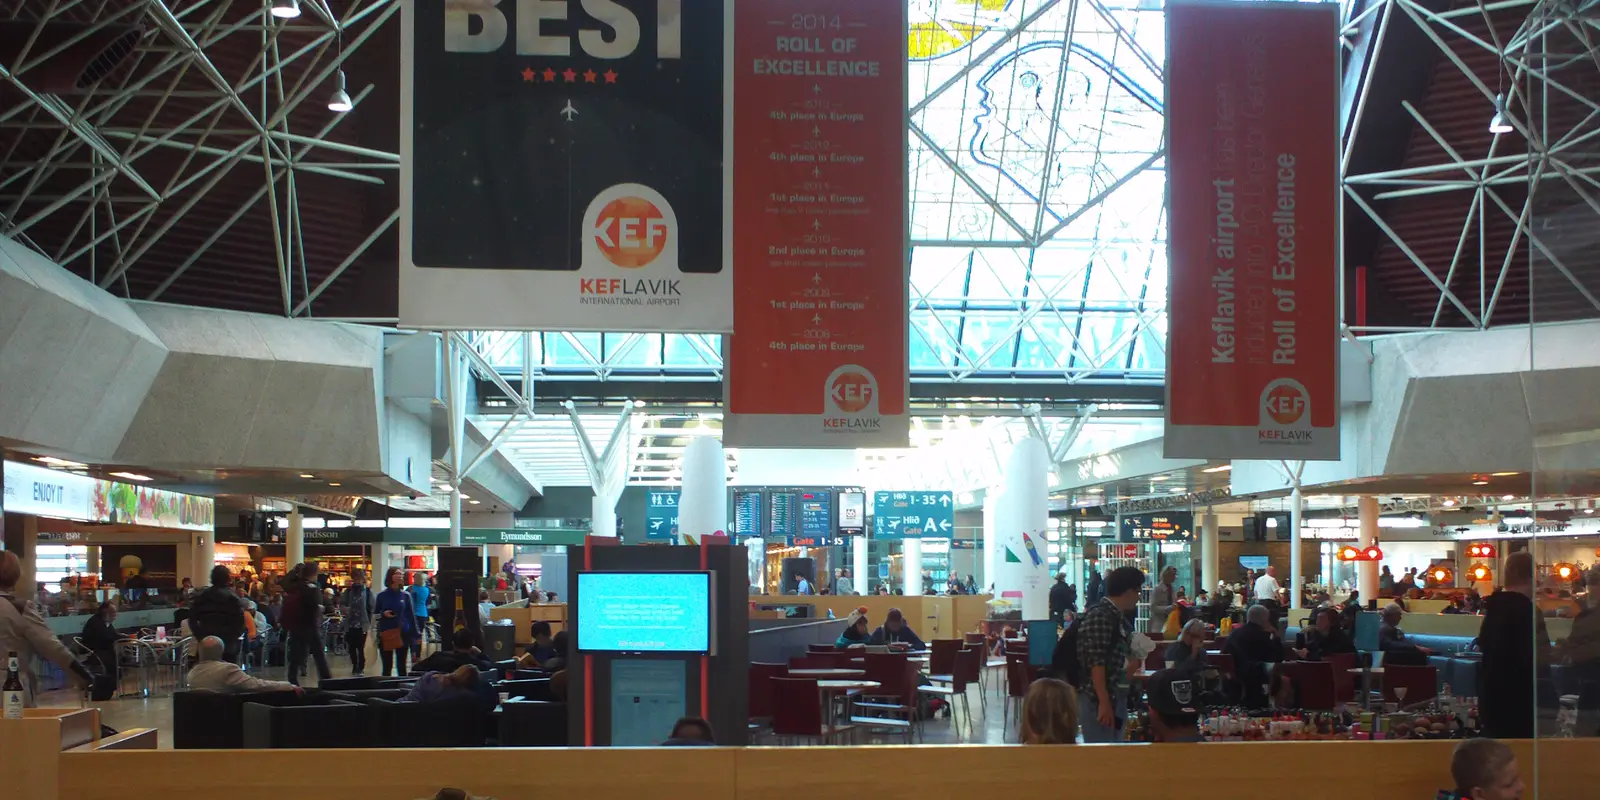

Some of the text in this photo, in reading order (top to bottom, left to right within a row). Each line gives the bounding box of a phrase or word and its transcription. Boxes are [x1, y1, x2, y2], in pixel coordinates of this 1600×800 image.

[792, 13, 841, 30] 2014
[776, 36, 857, 53] ROLL OF
[753, 58, 880, 77] EXCELLENCE
[769, 111, 786, 120] 4th
[790, 112, 815, 123] place
[830, 112, 864, 123] Europe
[769, 152, 786, 161] 4th
[790, 153, 815, 163] place
[830, 153, 864, 164] Europe
[1211, 178, 1240, 259] airport
[595, 217, 667, 248] KEF
[768, 246, 865, 257] 2nd place in Europe
[1272, 153, 1296, 365] Roll of Excellence
[580, 278, 681, 295] KEFLAVIK
[580, 297, 680, 306] INTERNATIONAL AIRPORT
[770, 300, 865, 311] 1st place in Europe
[1211, 267, 1235, 363] Keflavik
[769, 341, 865, 352] 4th place in Europe
[832, 383, 872, 401] KEF
[1266, 396, 1303, 414] KEF
[823, 418, 881, 428] KEFLAVIK
[1258, 430, 1313, 441] KEFLAVIK
[33, 481, 57, 503] ENJOY
[57, 486, 64, 504] IT
[902, 515, 938, 533] Hlið A
[903, 526, 923, 535] Gate
[500, 531, 542, 542] Eymundsson
[793, 537, 815, 546] Gate
